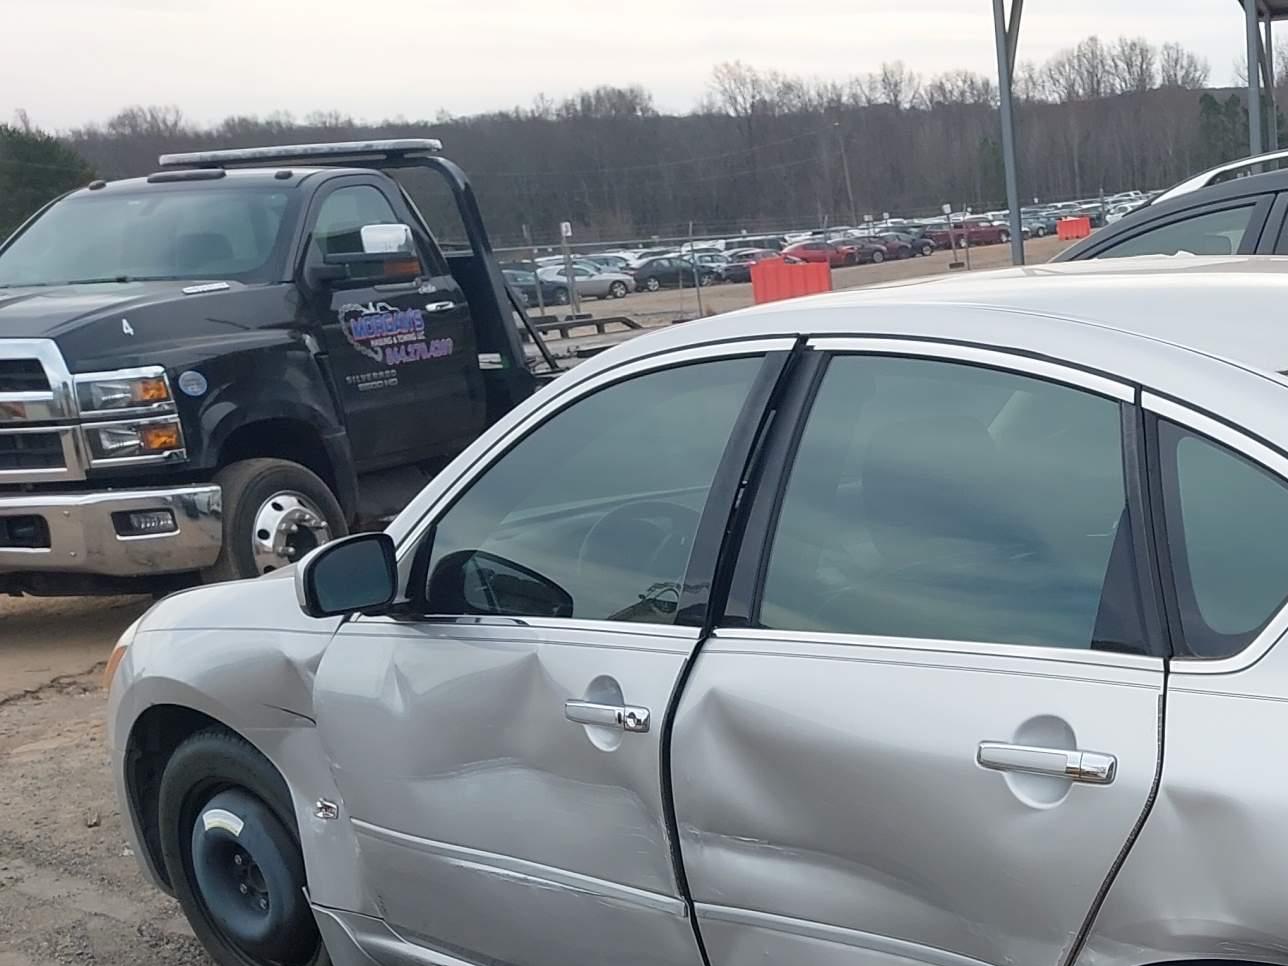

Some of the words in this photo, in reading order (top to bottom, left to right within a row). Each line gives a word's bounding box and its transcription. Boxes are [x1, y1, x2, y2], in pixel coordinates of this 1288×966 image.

[122, 318, 134, 336] 4
[350, 307, 425, 341] MORGAN'S
[345, 369, 397, 384] SILVERADO
